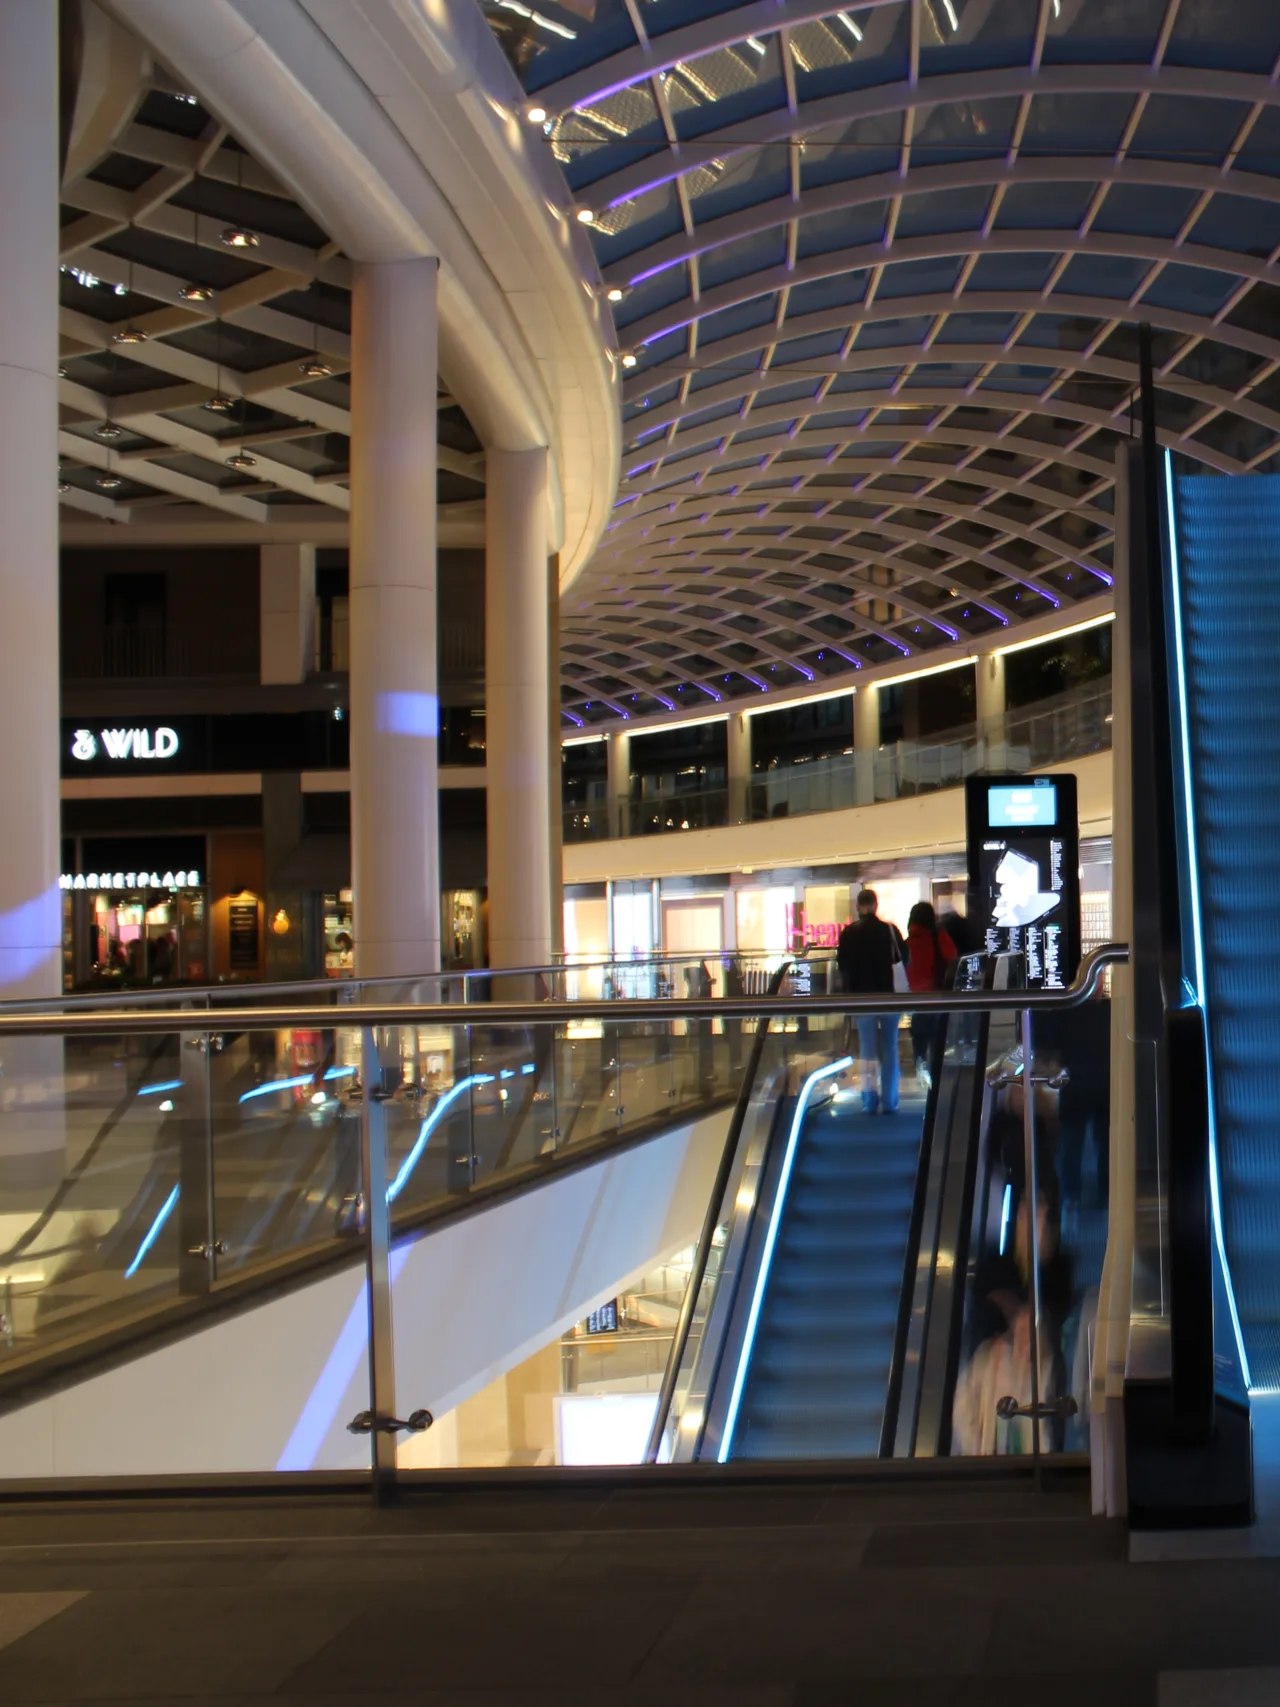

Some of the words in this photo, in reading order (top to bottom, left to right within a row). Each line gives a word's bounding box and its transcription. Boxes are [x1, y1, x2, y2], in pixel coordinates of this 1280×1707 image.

[72, 729, 97, 760] &
[101, 727, 179, 758] WILD
[59, 871, 200, 889] MARKETPLACE
